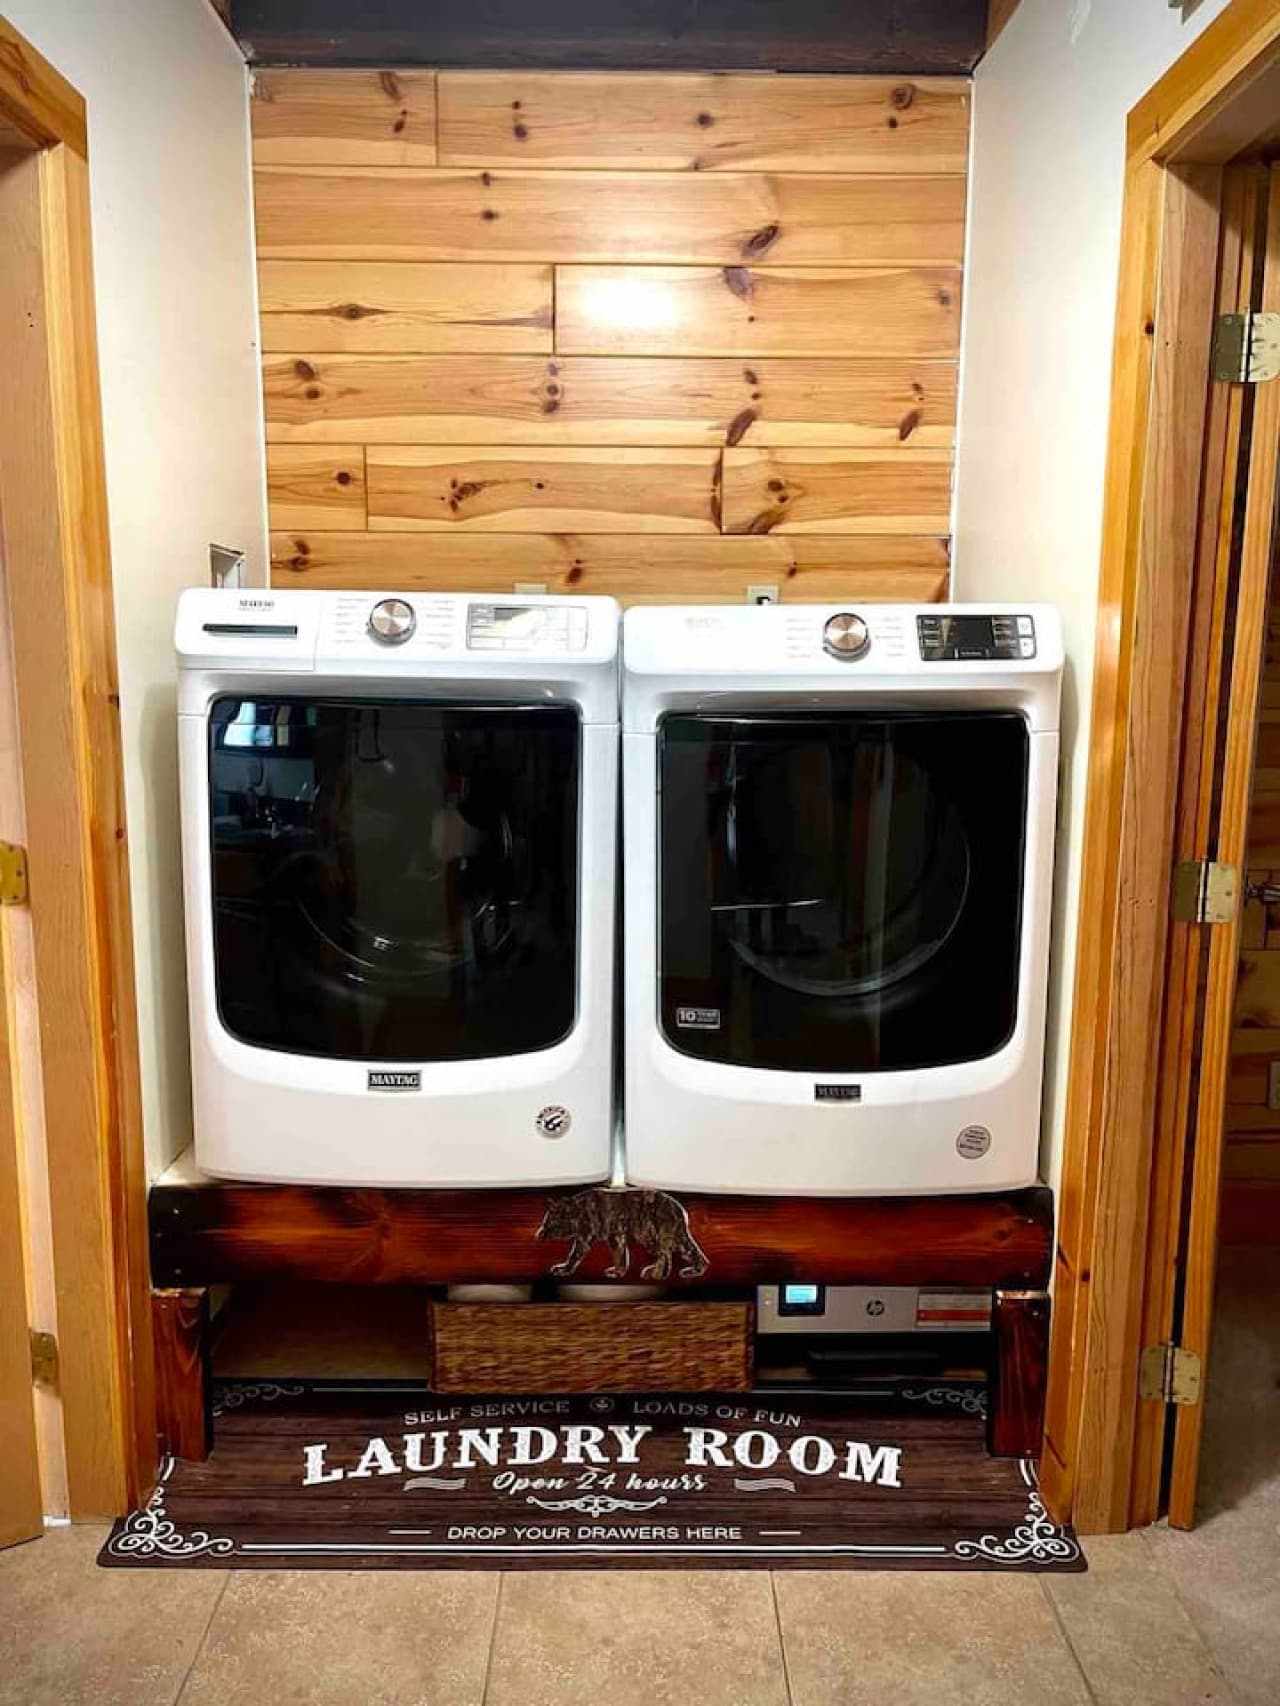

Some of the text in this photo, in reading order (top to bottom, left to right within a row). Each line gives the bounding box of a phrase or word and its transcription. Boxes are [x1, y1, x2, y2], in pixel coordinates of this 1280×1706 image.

[679, 1010, 696, 1022] 10
[369, 1073, 419, 1086] MAYTAG
[404, 1400, 570, 1426] SELF SERVICE
[632, 1400, 802, 1428] LOADS OF FUN
[301, 1424, 903, 1488] LAUNDRY ROOM
[491, 1470, 709, 1496] Open 24 hours
[447, 1526, 743, 1541] DROP YOUR DRAWERS HERE
